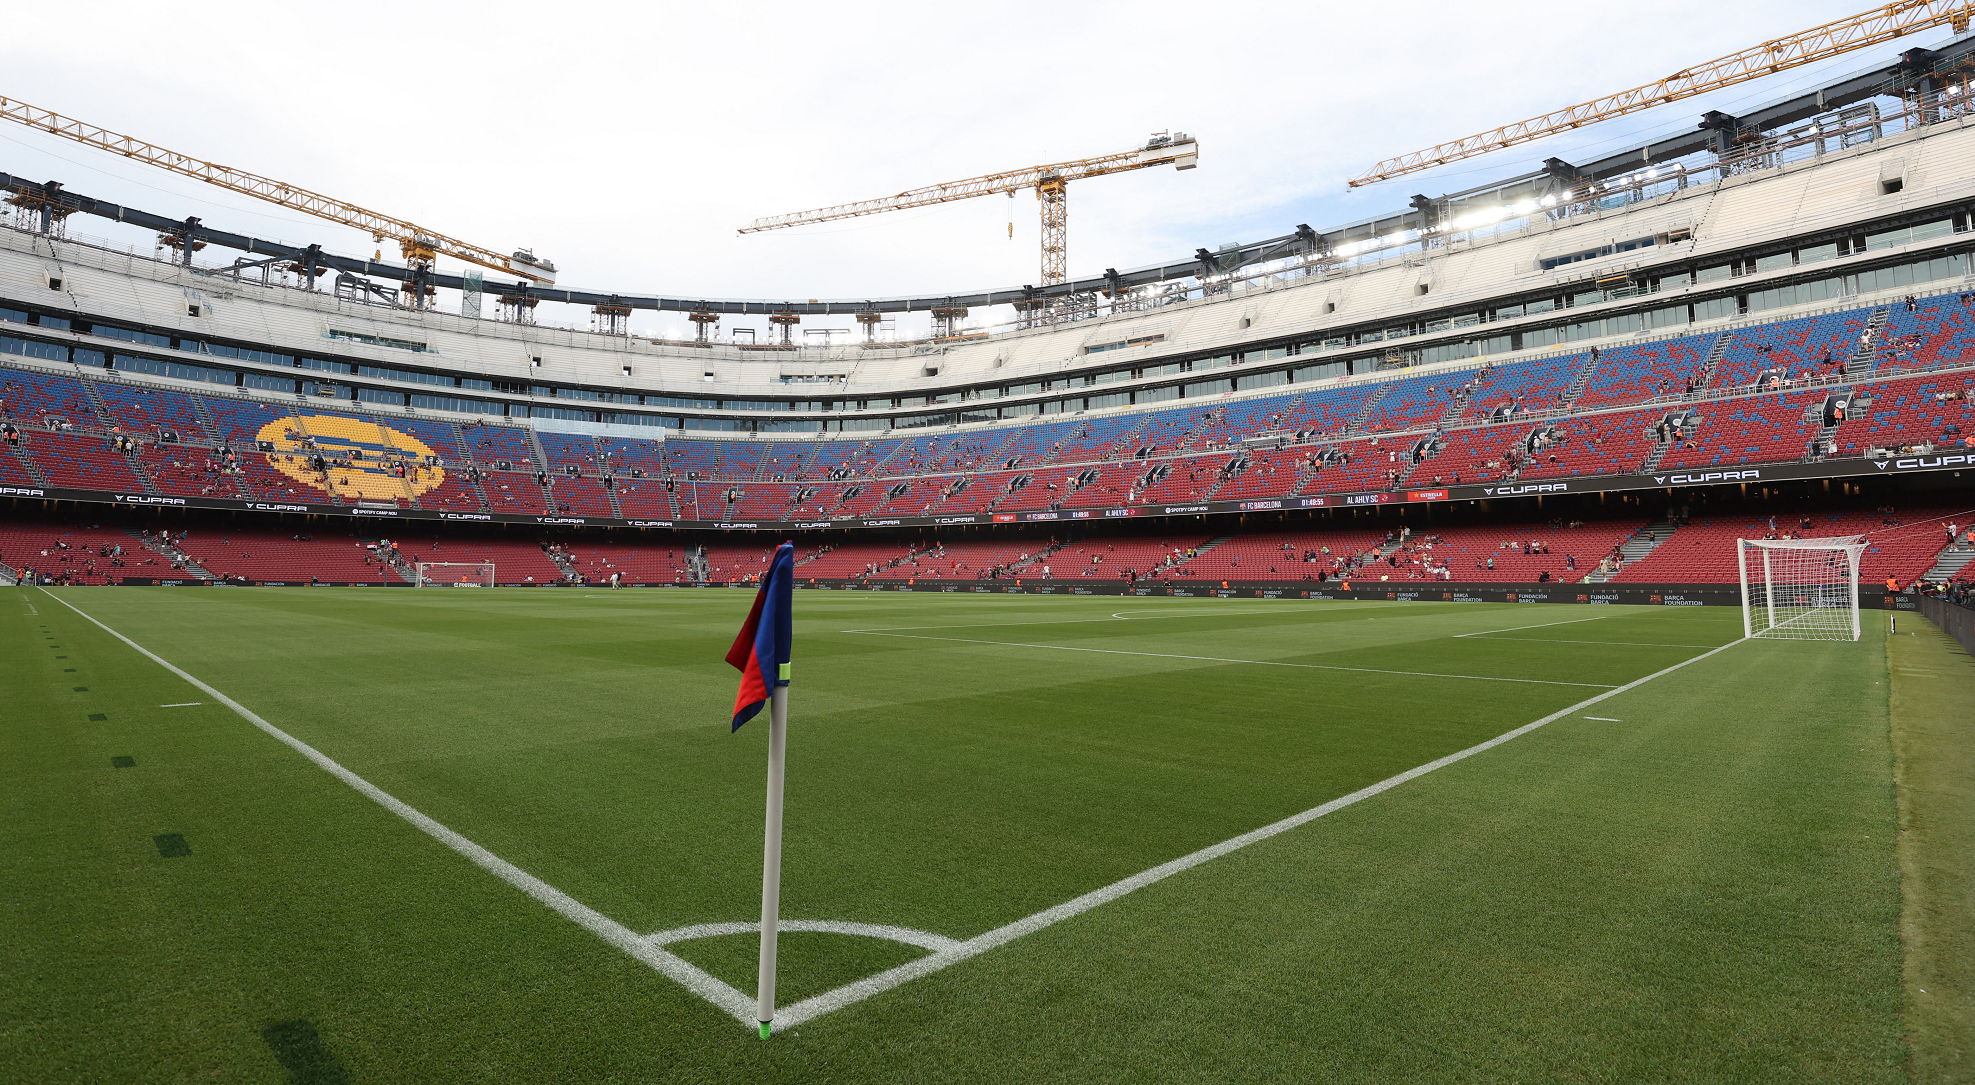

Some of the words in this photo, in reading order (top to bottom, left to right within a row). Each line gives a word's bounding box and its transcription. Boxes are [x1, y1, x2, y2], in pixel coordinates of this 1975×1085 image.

[1670, 470, 1759, 484] CUPRA
[0, 488, 44, 496] PRA
[1497, 483, 1568, 494] CUPRA
[126, 496, 185, 505] CUPRA
[1254, 501, 1282, 509] BARCELONA
[256, 503, 307, 512] CUPRA
